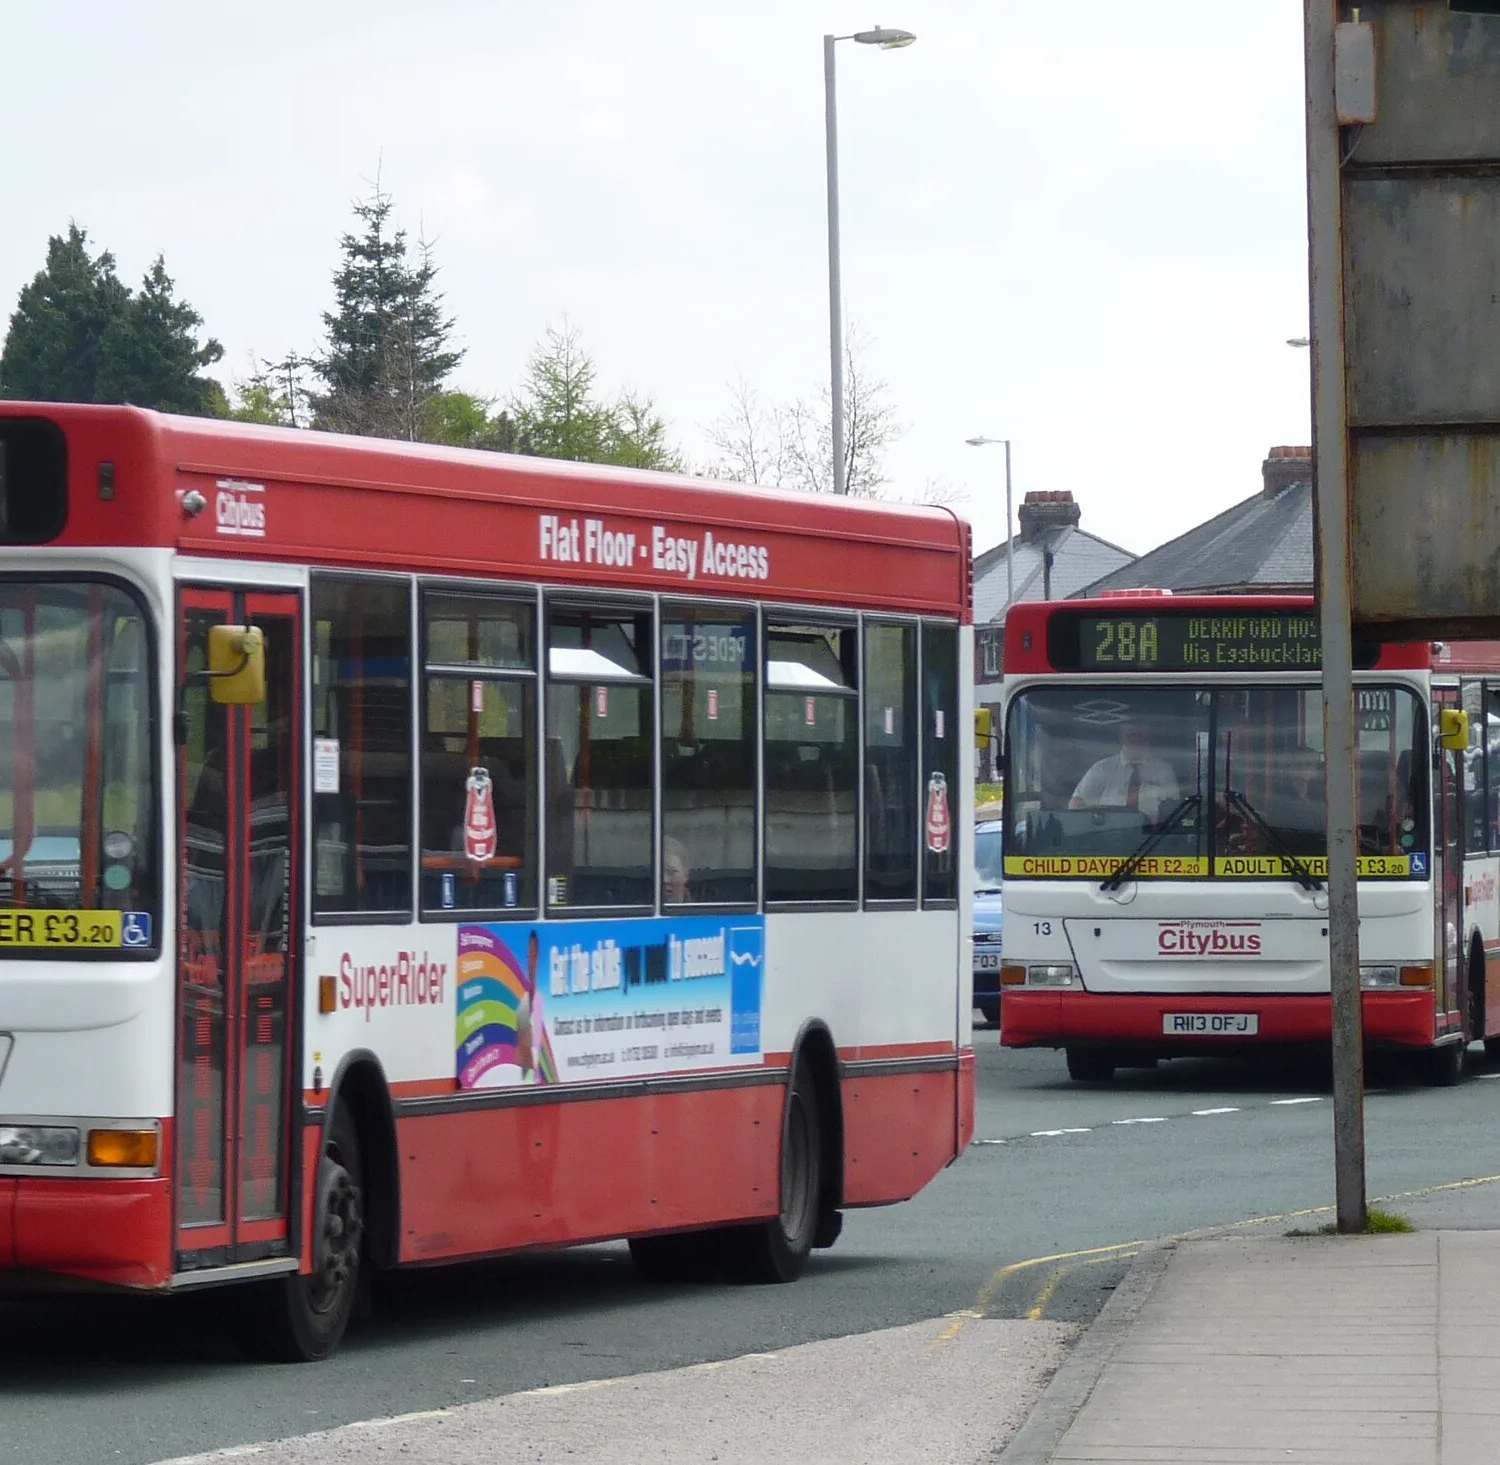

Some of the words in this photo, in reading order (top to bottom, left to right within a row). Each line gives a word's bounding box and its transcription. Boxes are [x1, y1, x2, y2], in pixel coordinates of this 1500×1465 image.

[540, 515, 580, 562] Flat
[585, 519, 635, 567] Floor
[652, 526, 697, 581] Easy
[702, 531, 768, 580] Access
[1096, 622, 1158, 662] 28A
[1189, 618, 1282, 638] DERRIFORD
[1023, 859, 1071, 874] CHILD
[1164, 858, 1200, 874] £2.20
[1223, 859, 1276, 874] ADULT
[1281, 859, 1363, 874] DAYRIR
[1367, 859, 1404, 874] £3.20
[44, 914, 114, 944] £3.20
[1033, 921, 1053, 936] 13
[1180, 920, 1225, 930] Plymouth
[1158, 929, 1262, 955] Citybus
[340, 951, 447, 1022] SuperRider
[1174, 1016, 1206, 1031] R113
[1212, 1016, 1247, 1031] OFJ
